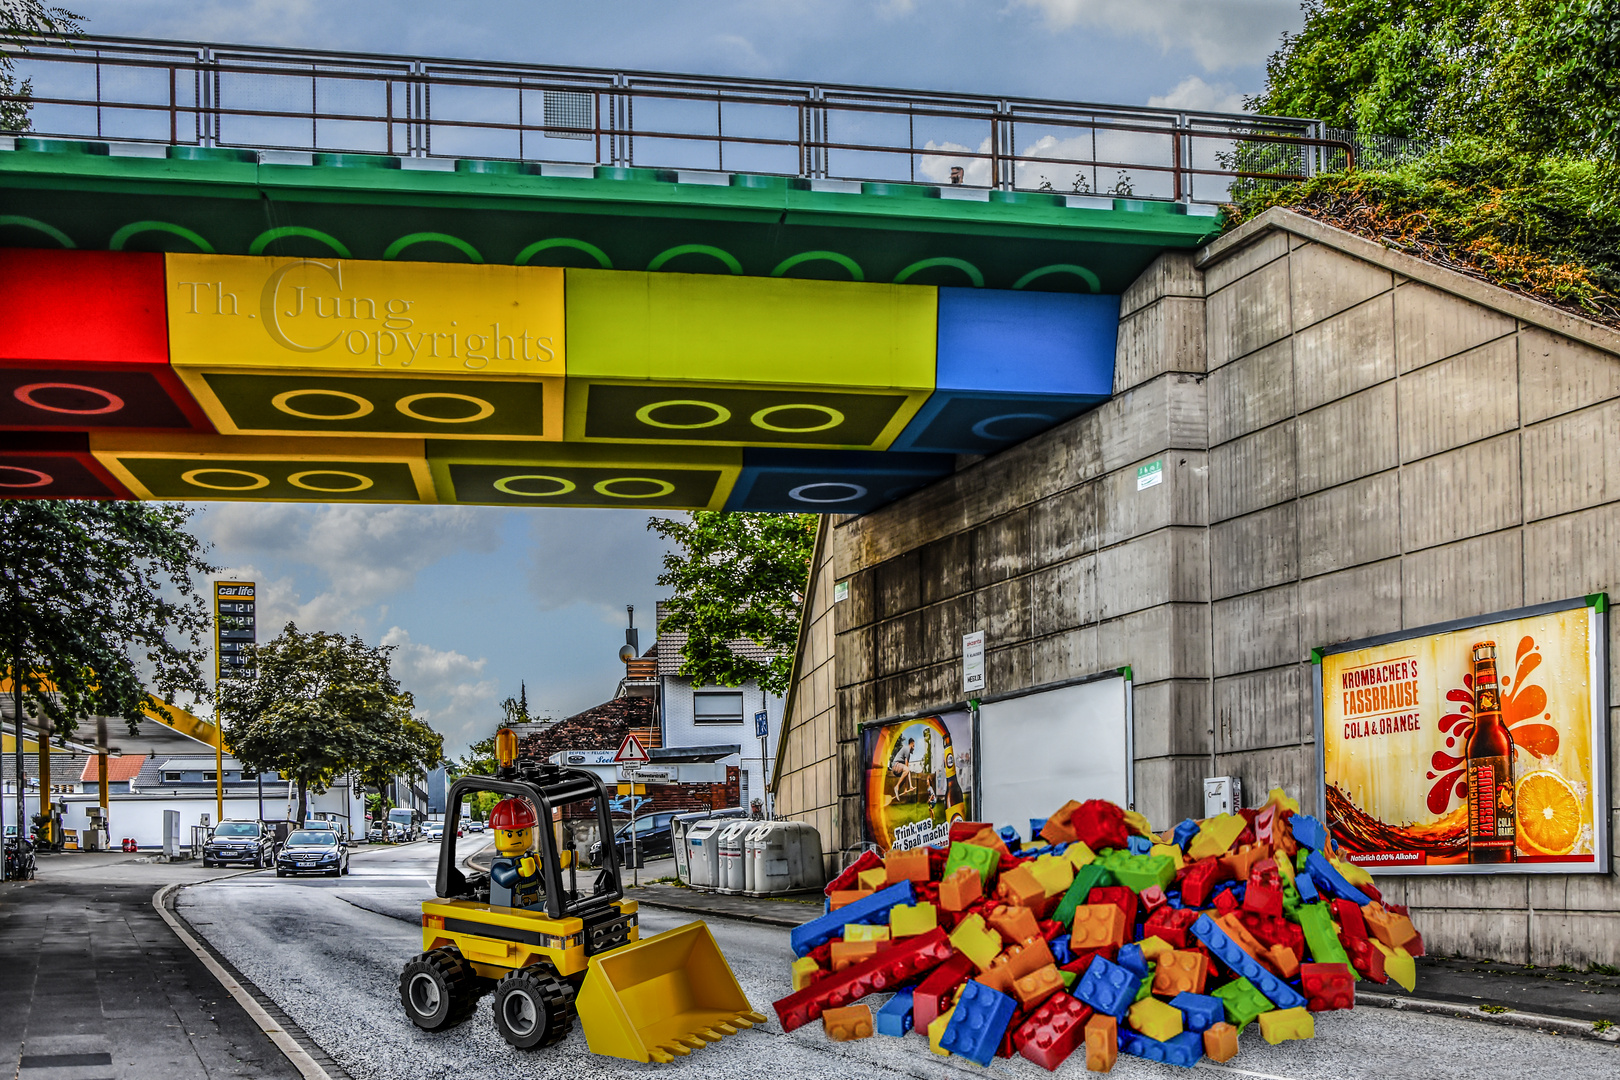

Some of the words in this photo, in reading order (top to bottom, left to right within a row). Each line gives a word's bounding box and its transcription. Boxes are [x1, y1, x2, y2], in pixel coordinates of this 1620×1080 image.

[218, 587, 238, 596] car
[238, 586, 254, 596] life
[1342, 659, 1418, 689] KROMBACHER'S
[1343, 680, 1419, 716] FASSBRAUSE
[1344, 720, 1370, 740] COLA
[1379, 713, 1421, 735] ORANGE
[1469, 766, 1479, 837] KROMBACHER'S
[1477, 765, 1494, 836] FASSBRAUSE
[903, 833, 922, 850] Spaß
[922, 823, 949, 844] macht!
[916, 819, 932, 833] was
[1350, 853, 1376, 862] Natürlich
[1394, 852, 1420, 860] Alkohol
